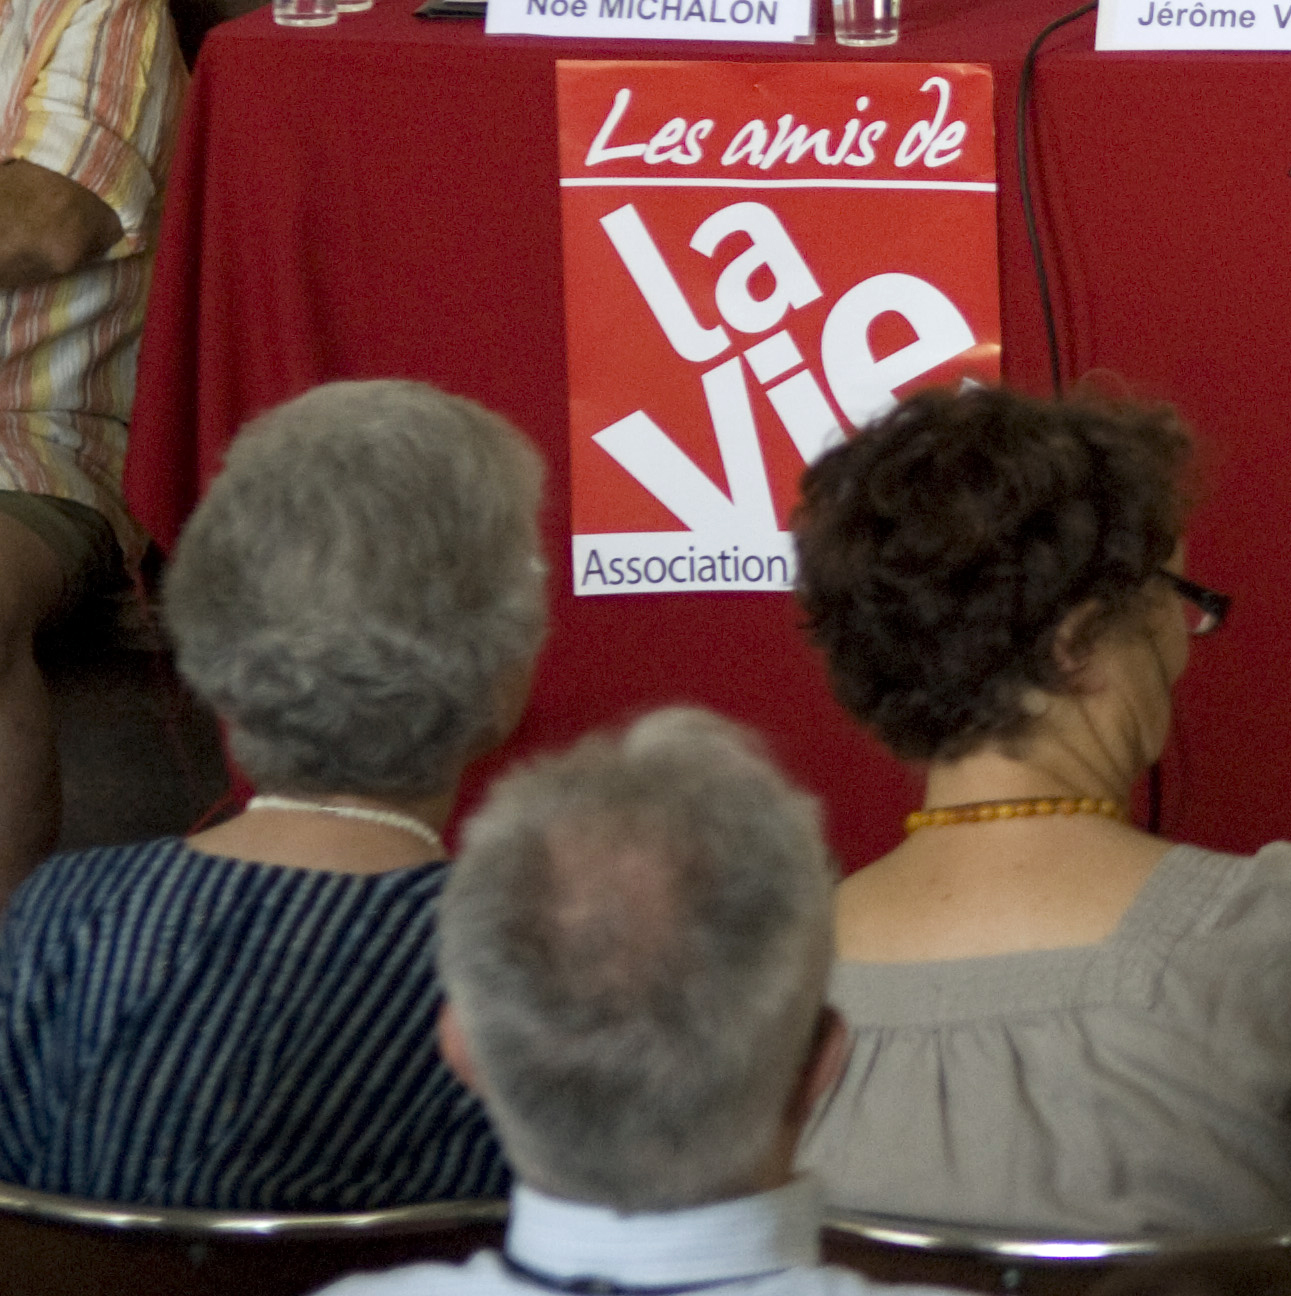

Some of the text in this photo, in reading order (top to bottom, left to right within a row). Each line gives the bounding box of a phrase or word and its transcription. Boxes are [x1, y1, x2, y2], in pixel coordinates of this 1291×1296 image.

[1137, 1, 1256, 29] Jérôme
[585, 76, 968, 171] Les amis de
[581, 546, 787, 588] Association
